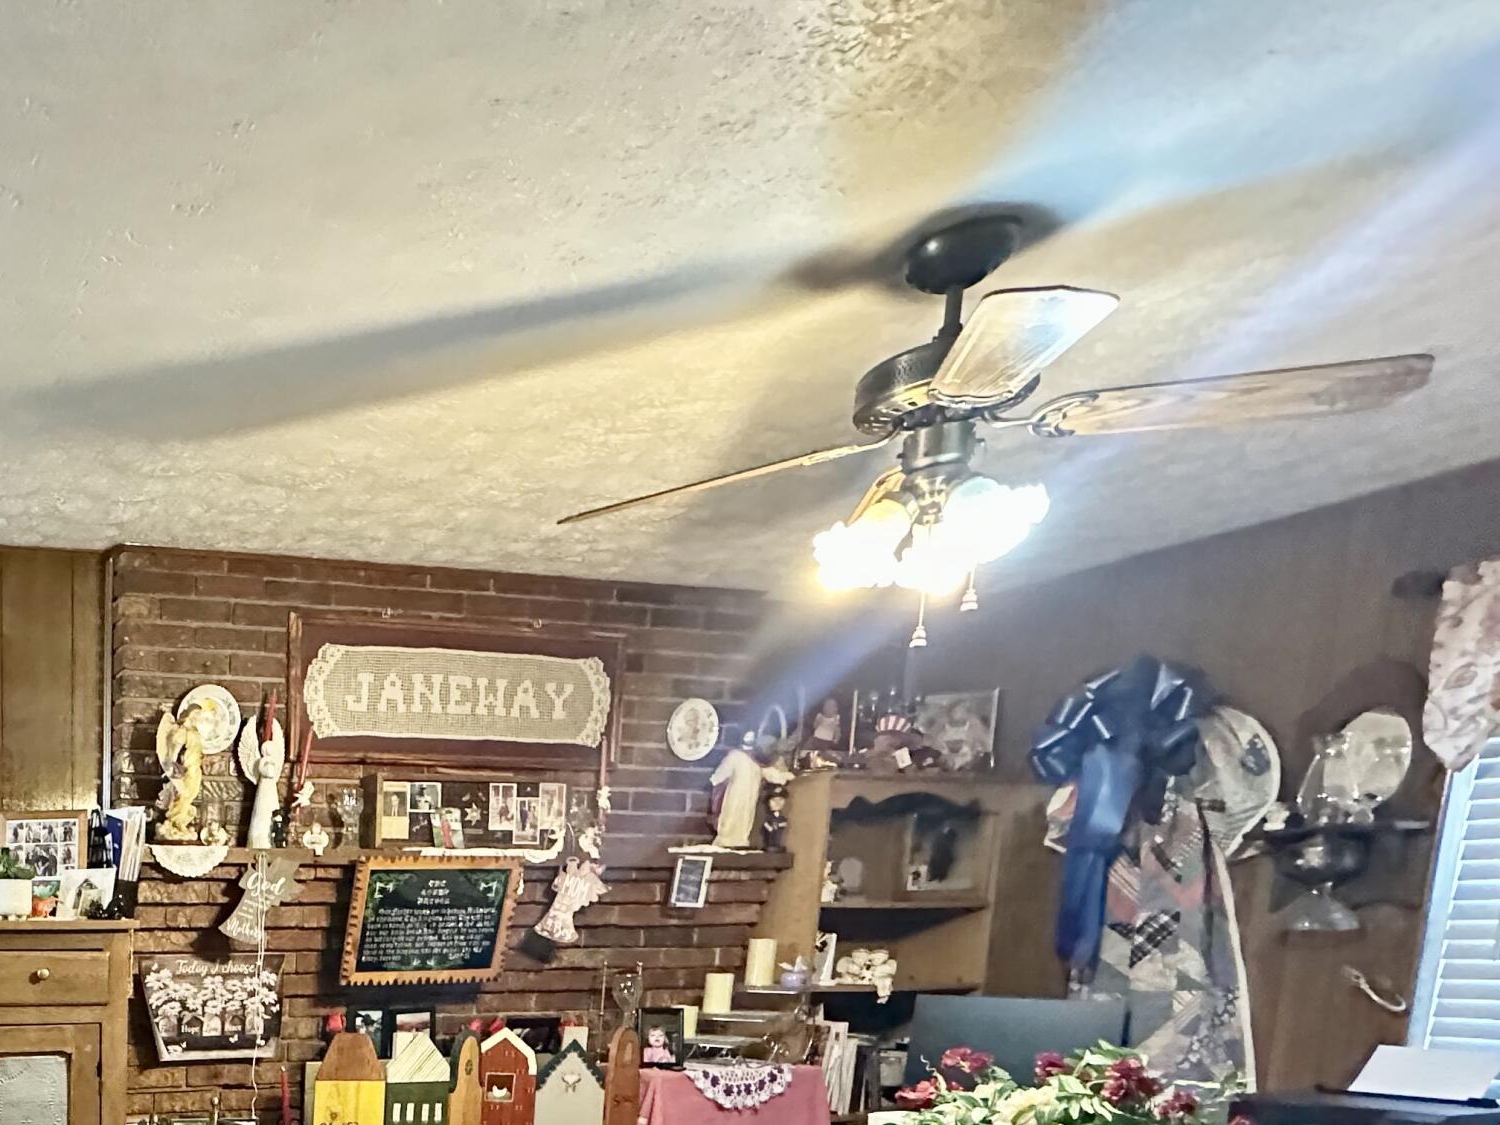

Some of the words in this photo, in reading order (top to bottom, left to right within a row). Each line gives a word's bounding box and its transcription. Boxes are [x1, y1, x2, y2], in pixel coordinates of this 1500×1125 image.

[344, 672, 574, 720] JANEWAY
[247, 872, 286, 897] God
[176, 959, 208, 977] Today
[221, 960, 256, 974] choose
